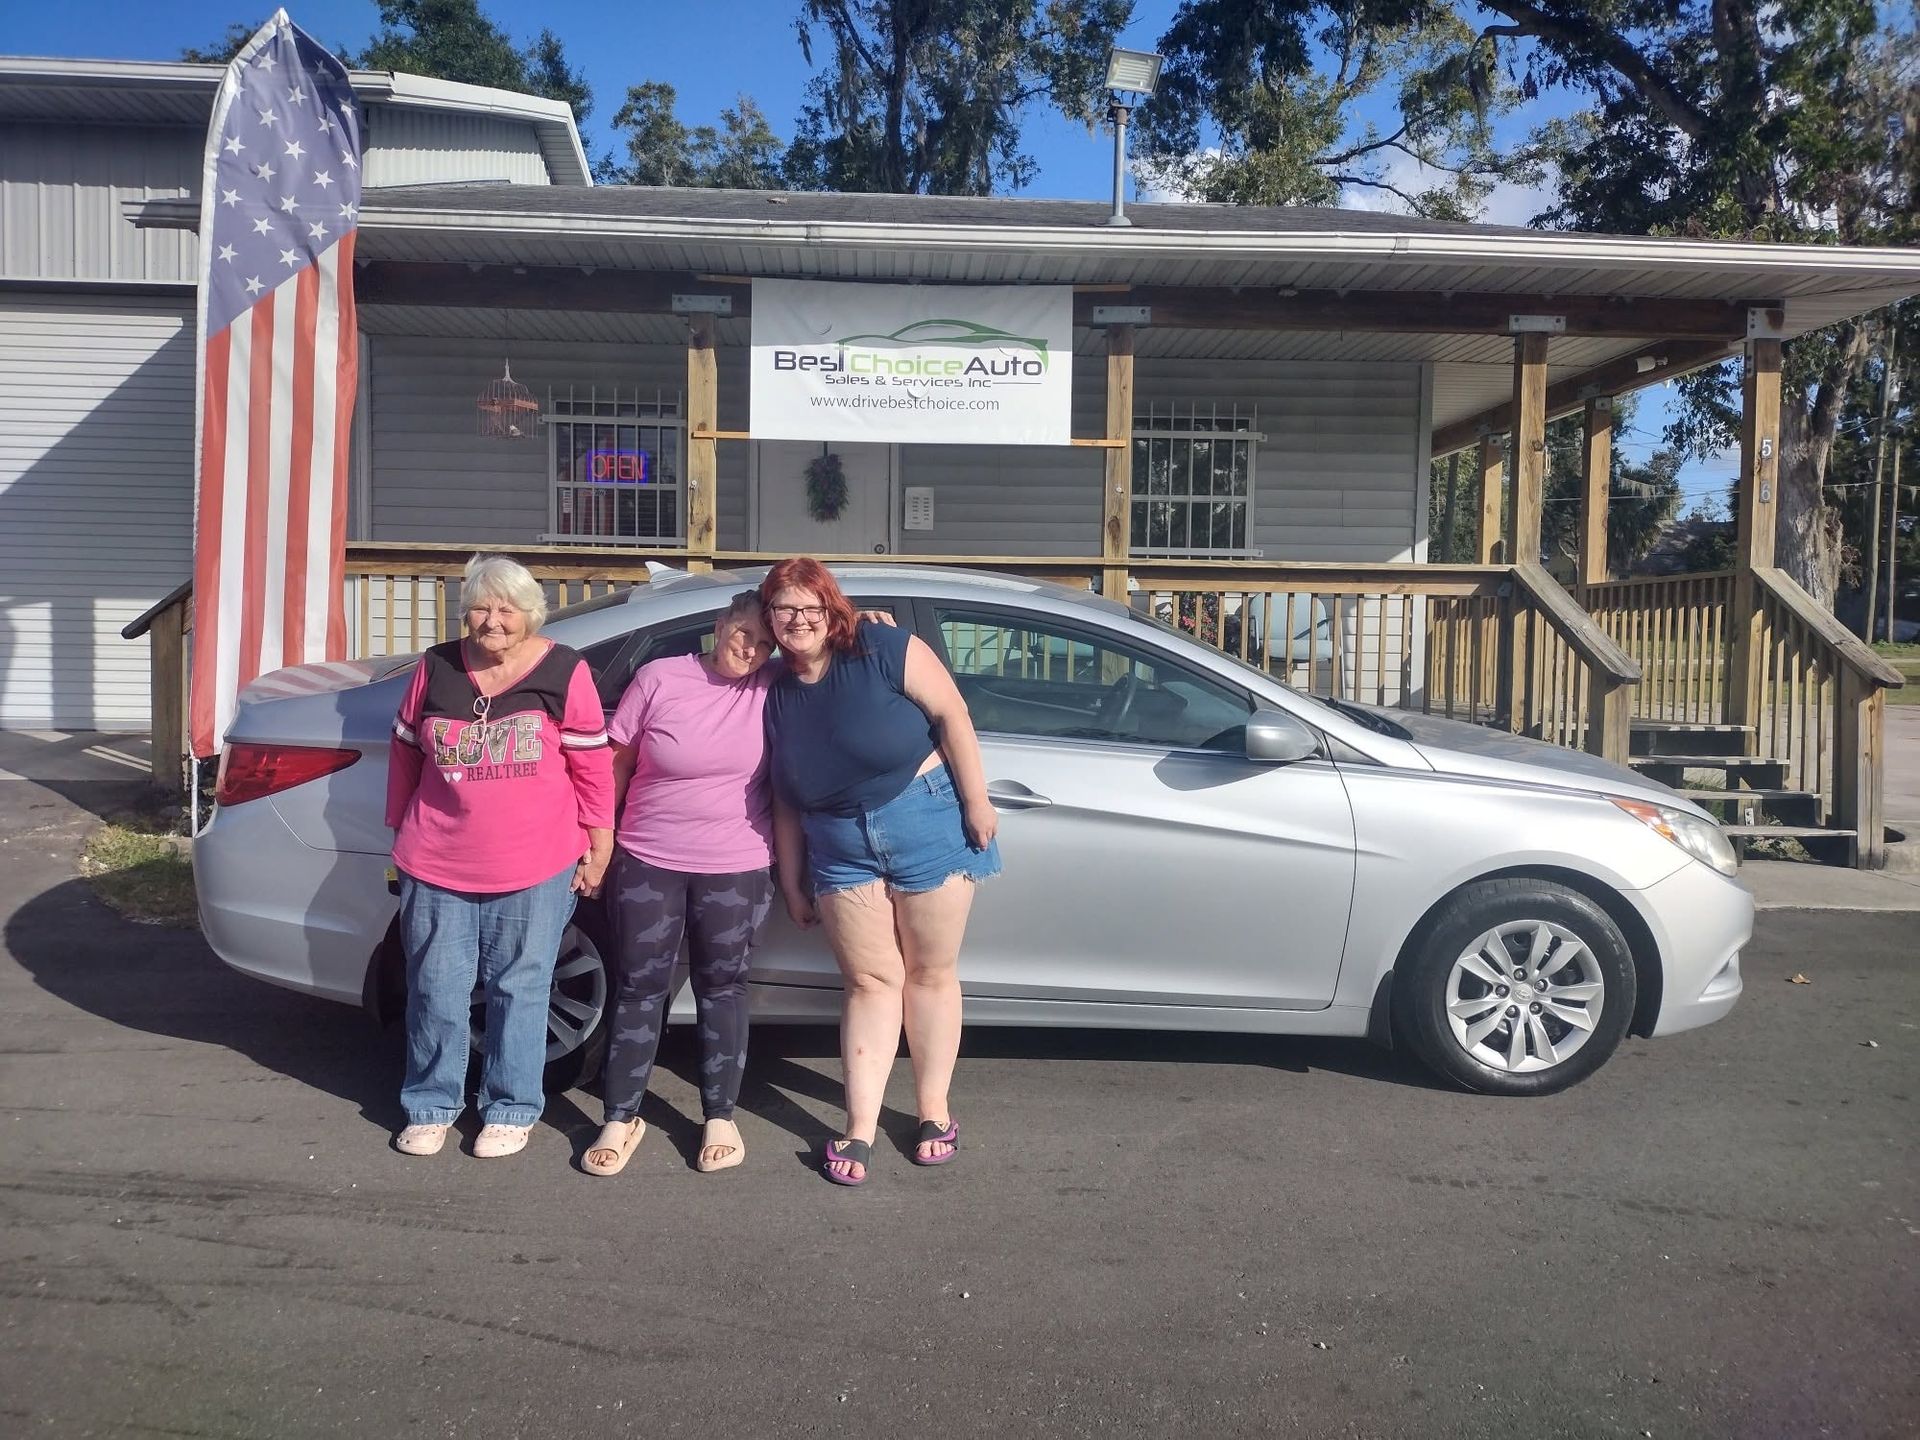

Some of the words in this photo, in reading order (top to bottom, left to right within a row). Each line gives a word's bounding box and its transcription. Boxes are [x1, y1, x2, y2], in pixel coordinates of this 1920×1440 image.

[850, 354, 963, 376] Choice
[963, 356, 1043, 376] Auto
[825, 374, 870, 385] Sales
[875, 375, 886, 386] &
[892, 376, 963, 388] Services
[968, 377, 992, 388] Inc
[810, 394, 1000, 411] www.drivebestchoice.com
[591, 454, 645, 480] OPEN
[433, 715, 542, 767] LOVE
